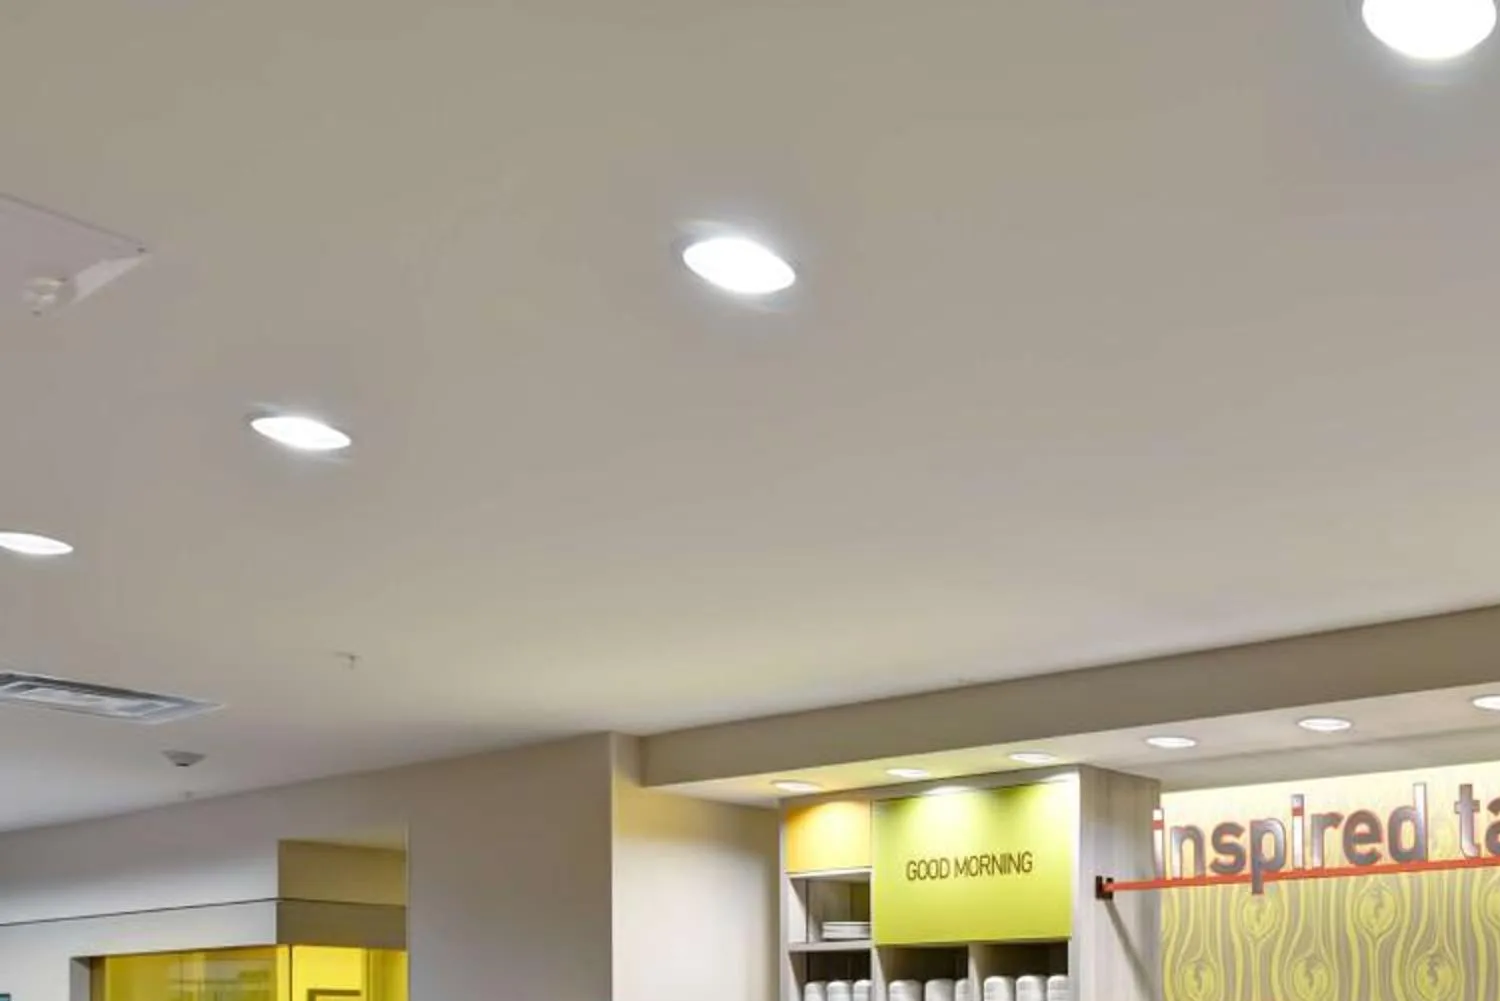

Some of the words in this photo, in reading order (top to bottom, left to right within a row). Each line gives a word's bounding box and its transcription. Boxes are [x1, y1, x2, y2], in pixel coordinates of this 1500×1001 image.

[906, 857, 951, 881] GOOD
[953, 850, 1033, 879] MORNING
[1152, 781, 1429, 895] inspired
